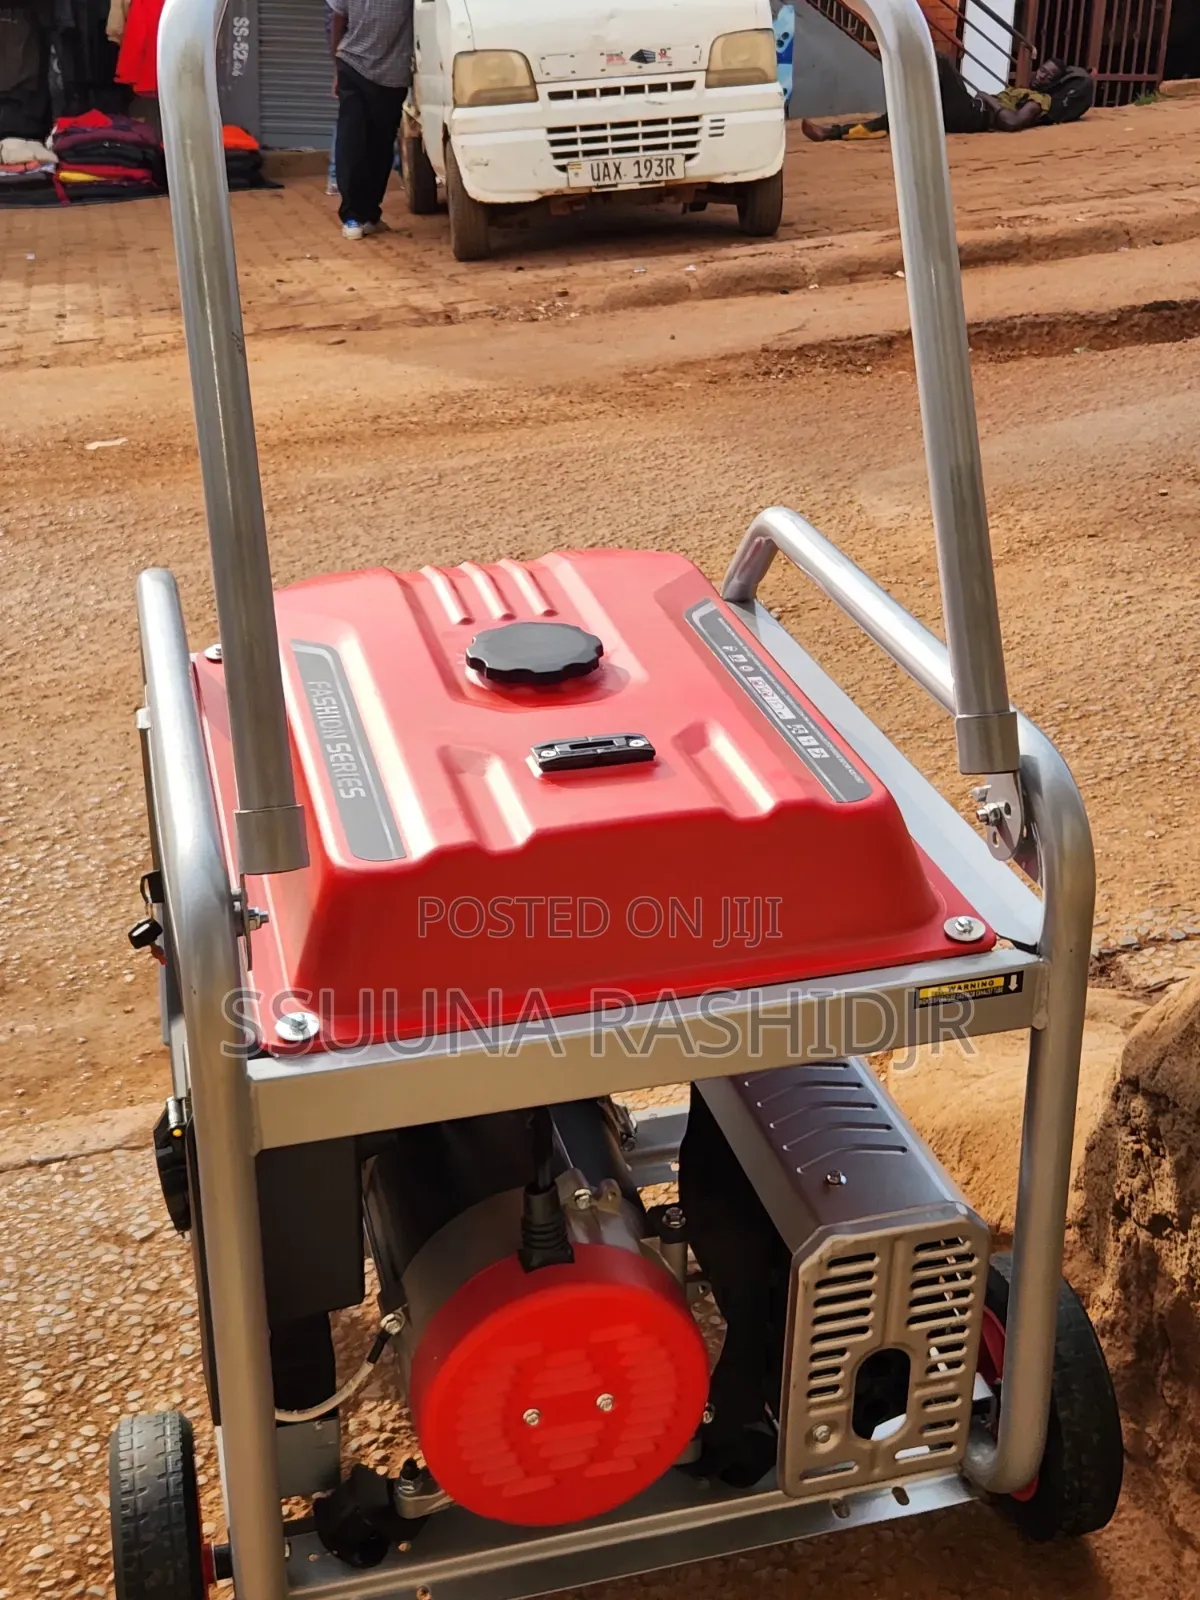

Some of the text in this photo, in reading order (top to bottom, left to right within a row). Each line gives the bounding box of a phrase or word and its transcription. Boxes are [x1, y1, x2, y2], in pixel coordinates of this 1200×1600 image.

[590, 157, 676, 182] UAX 193R
[307, 681, 366, 799] FASHION SERIES
[947, 979, 995, 993] WARNING
